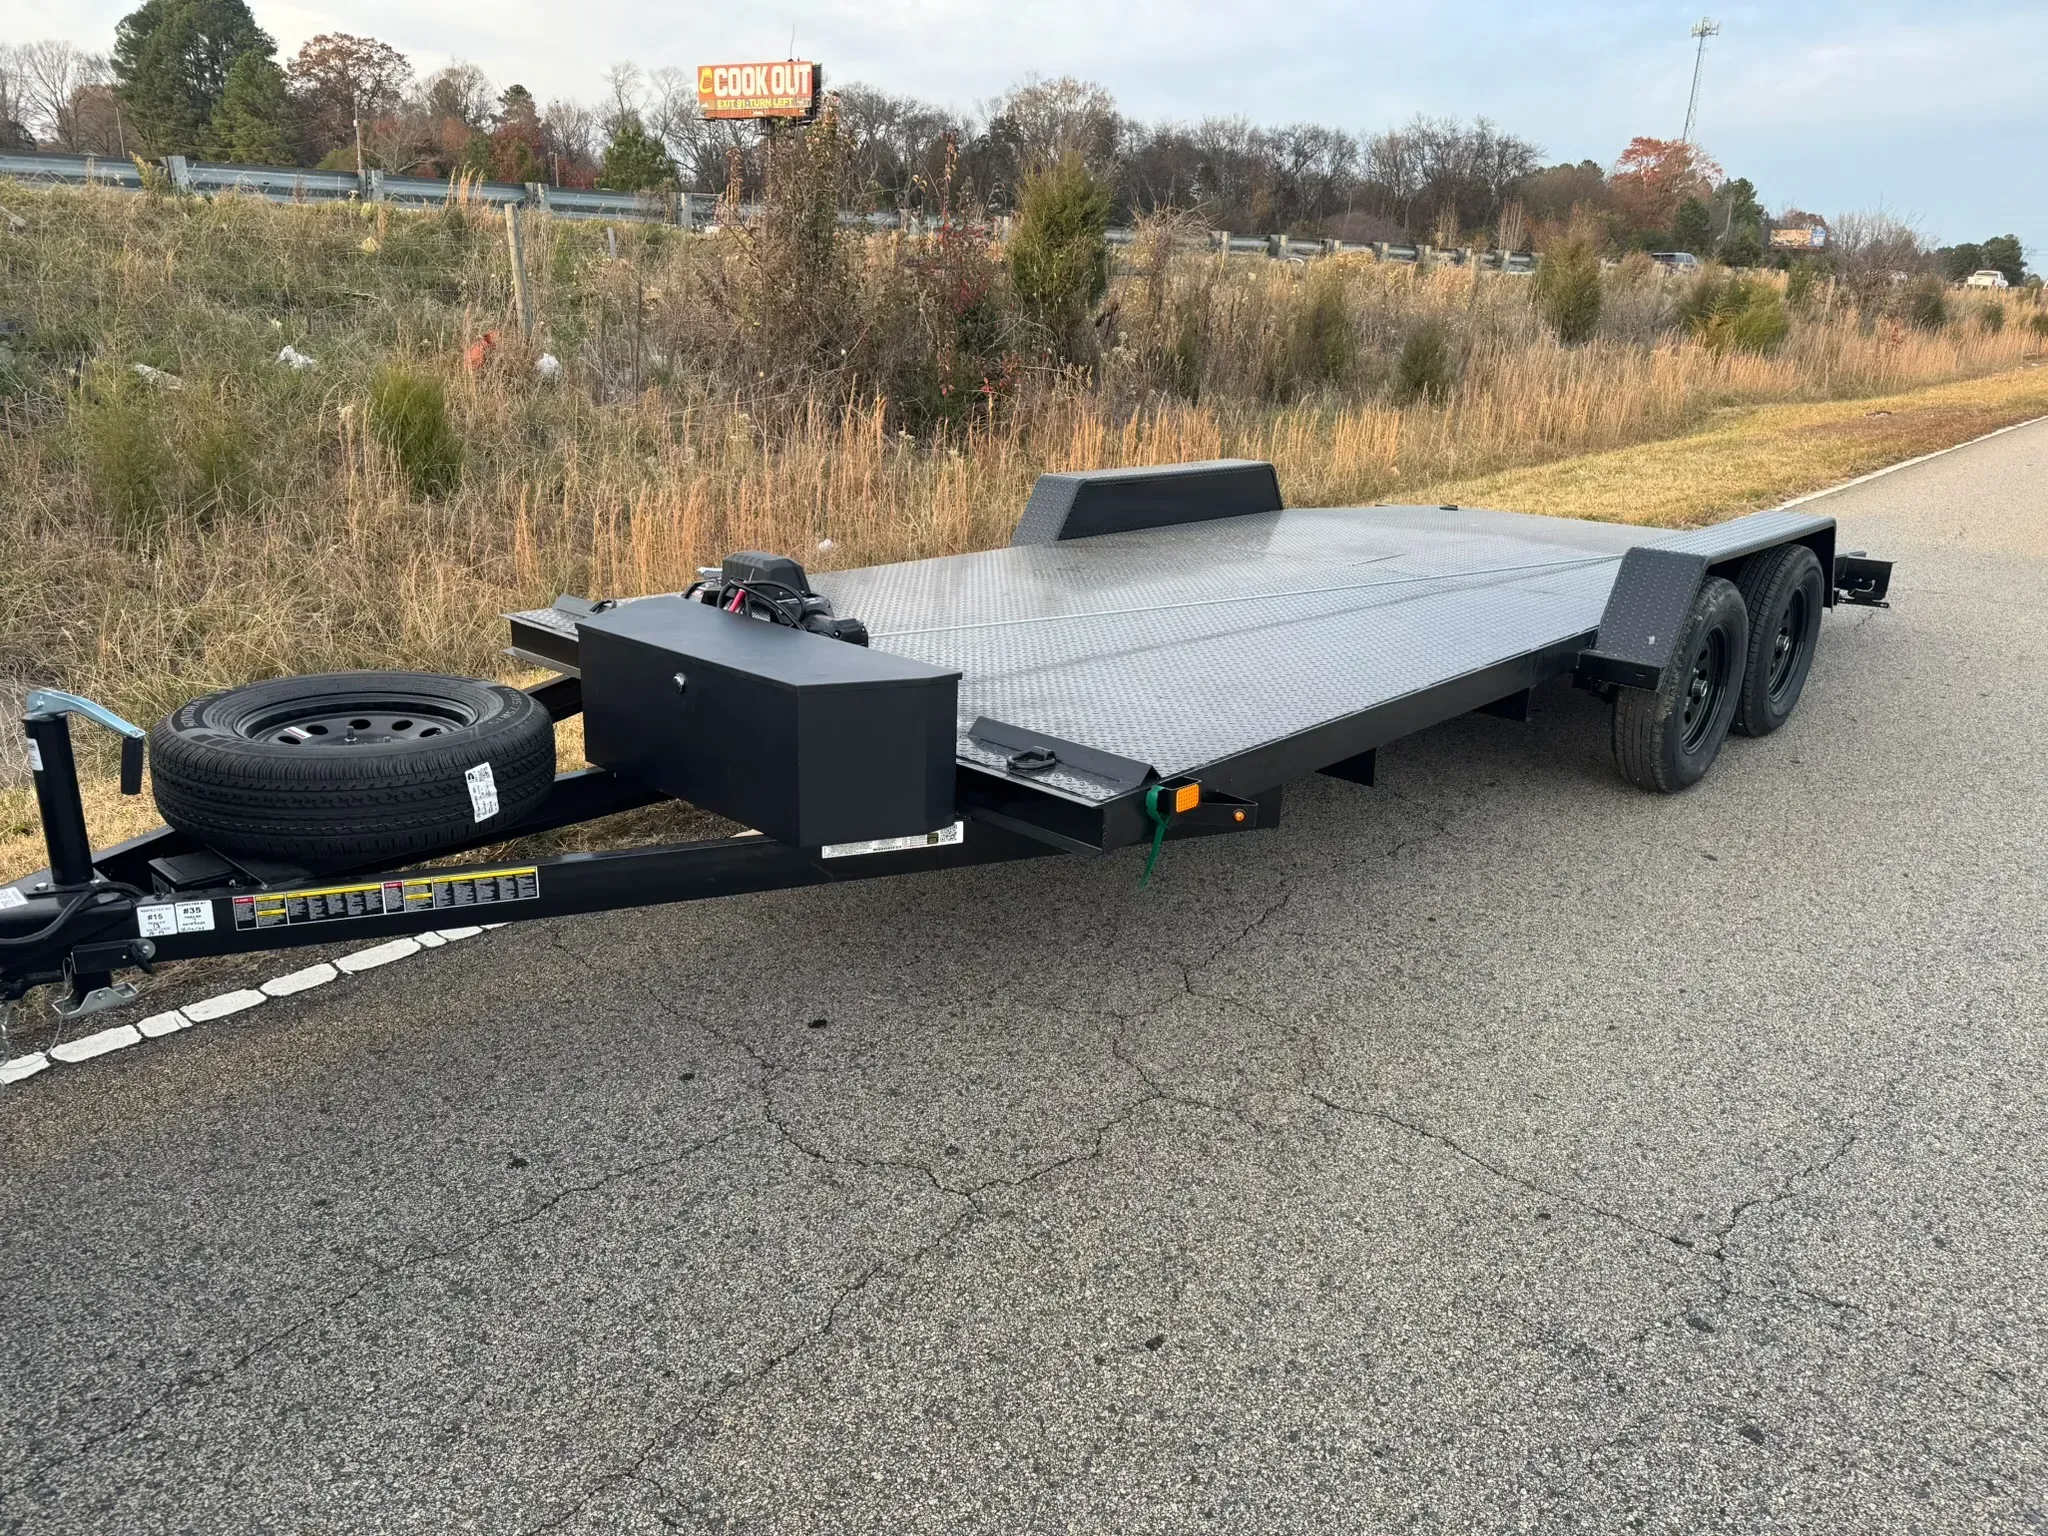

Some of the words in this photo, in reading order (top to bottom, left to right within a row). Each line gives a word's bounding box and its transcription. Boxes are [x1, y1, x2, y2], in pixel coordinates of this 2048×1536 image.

[713, 66, 769, 97] COOK
[771, 64, 810, 95] OUT
[717, 99, 736, 109] EXIT
[773, 97, 794, 107] LEFT
[183, 907, 202, 915] #35
[147, 913, 164, 921] #15
